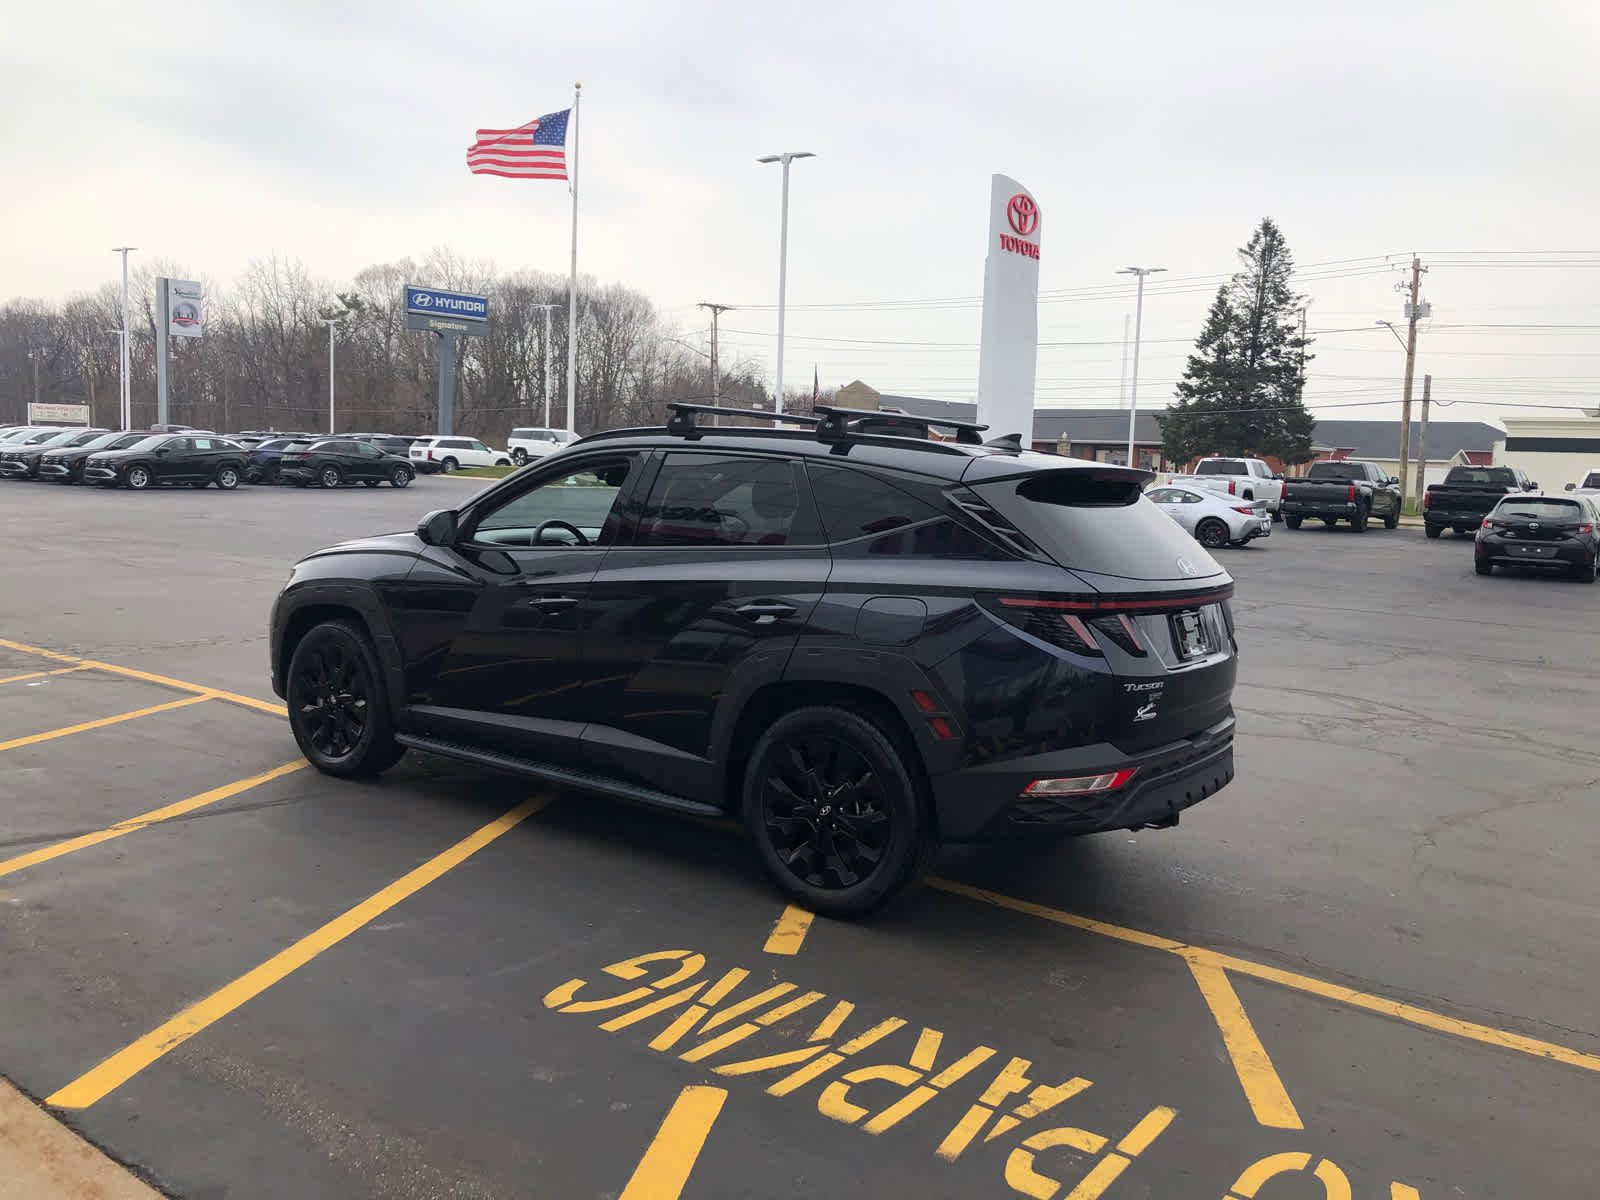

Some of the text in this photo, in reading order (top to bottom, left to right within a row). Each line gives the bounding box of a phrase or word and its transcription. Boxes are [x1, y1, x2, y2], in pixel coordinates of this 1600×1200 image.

[999, 233, 1040, 260] TOYOTA
[435, 297, 485, 313] HYUNDAI
[542, 949, 1177, 1200] PARKING
